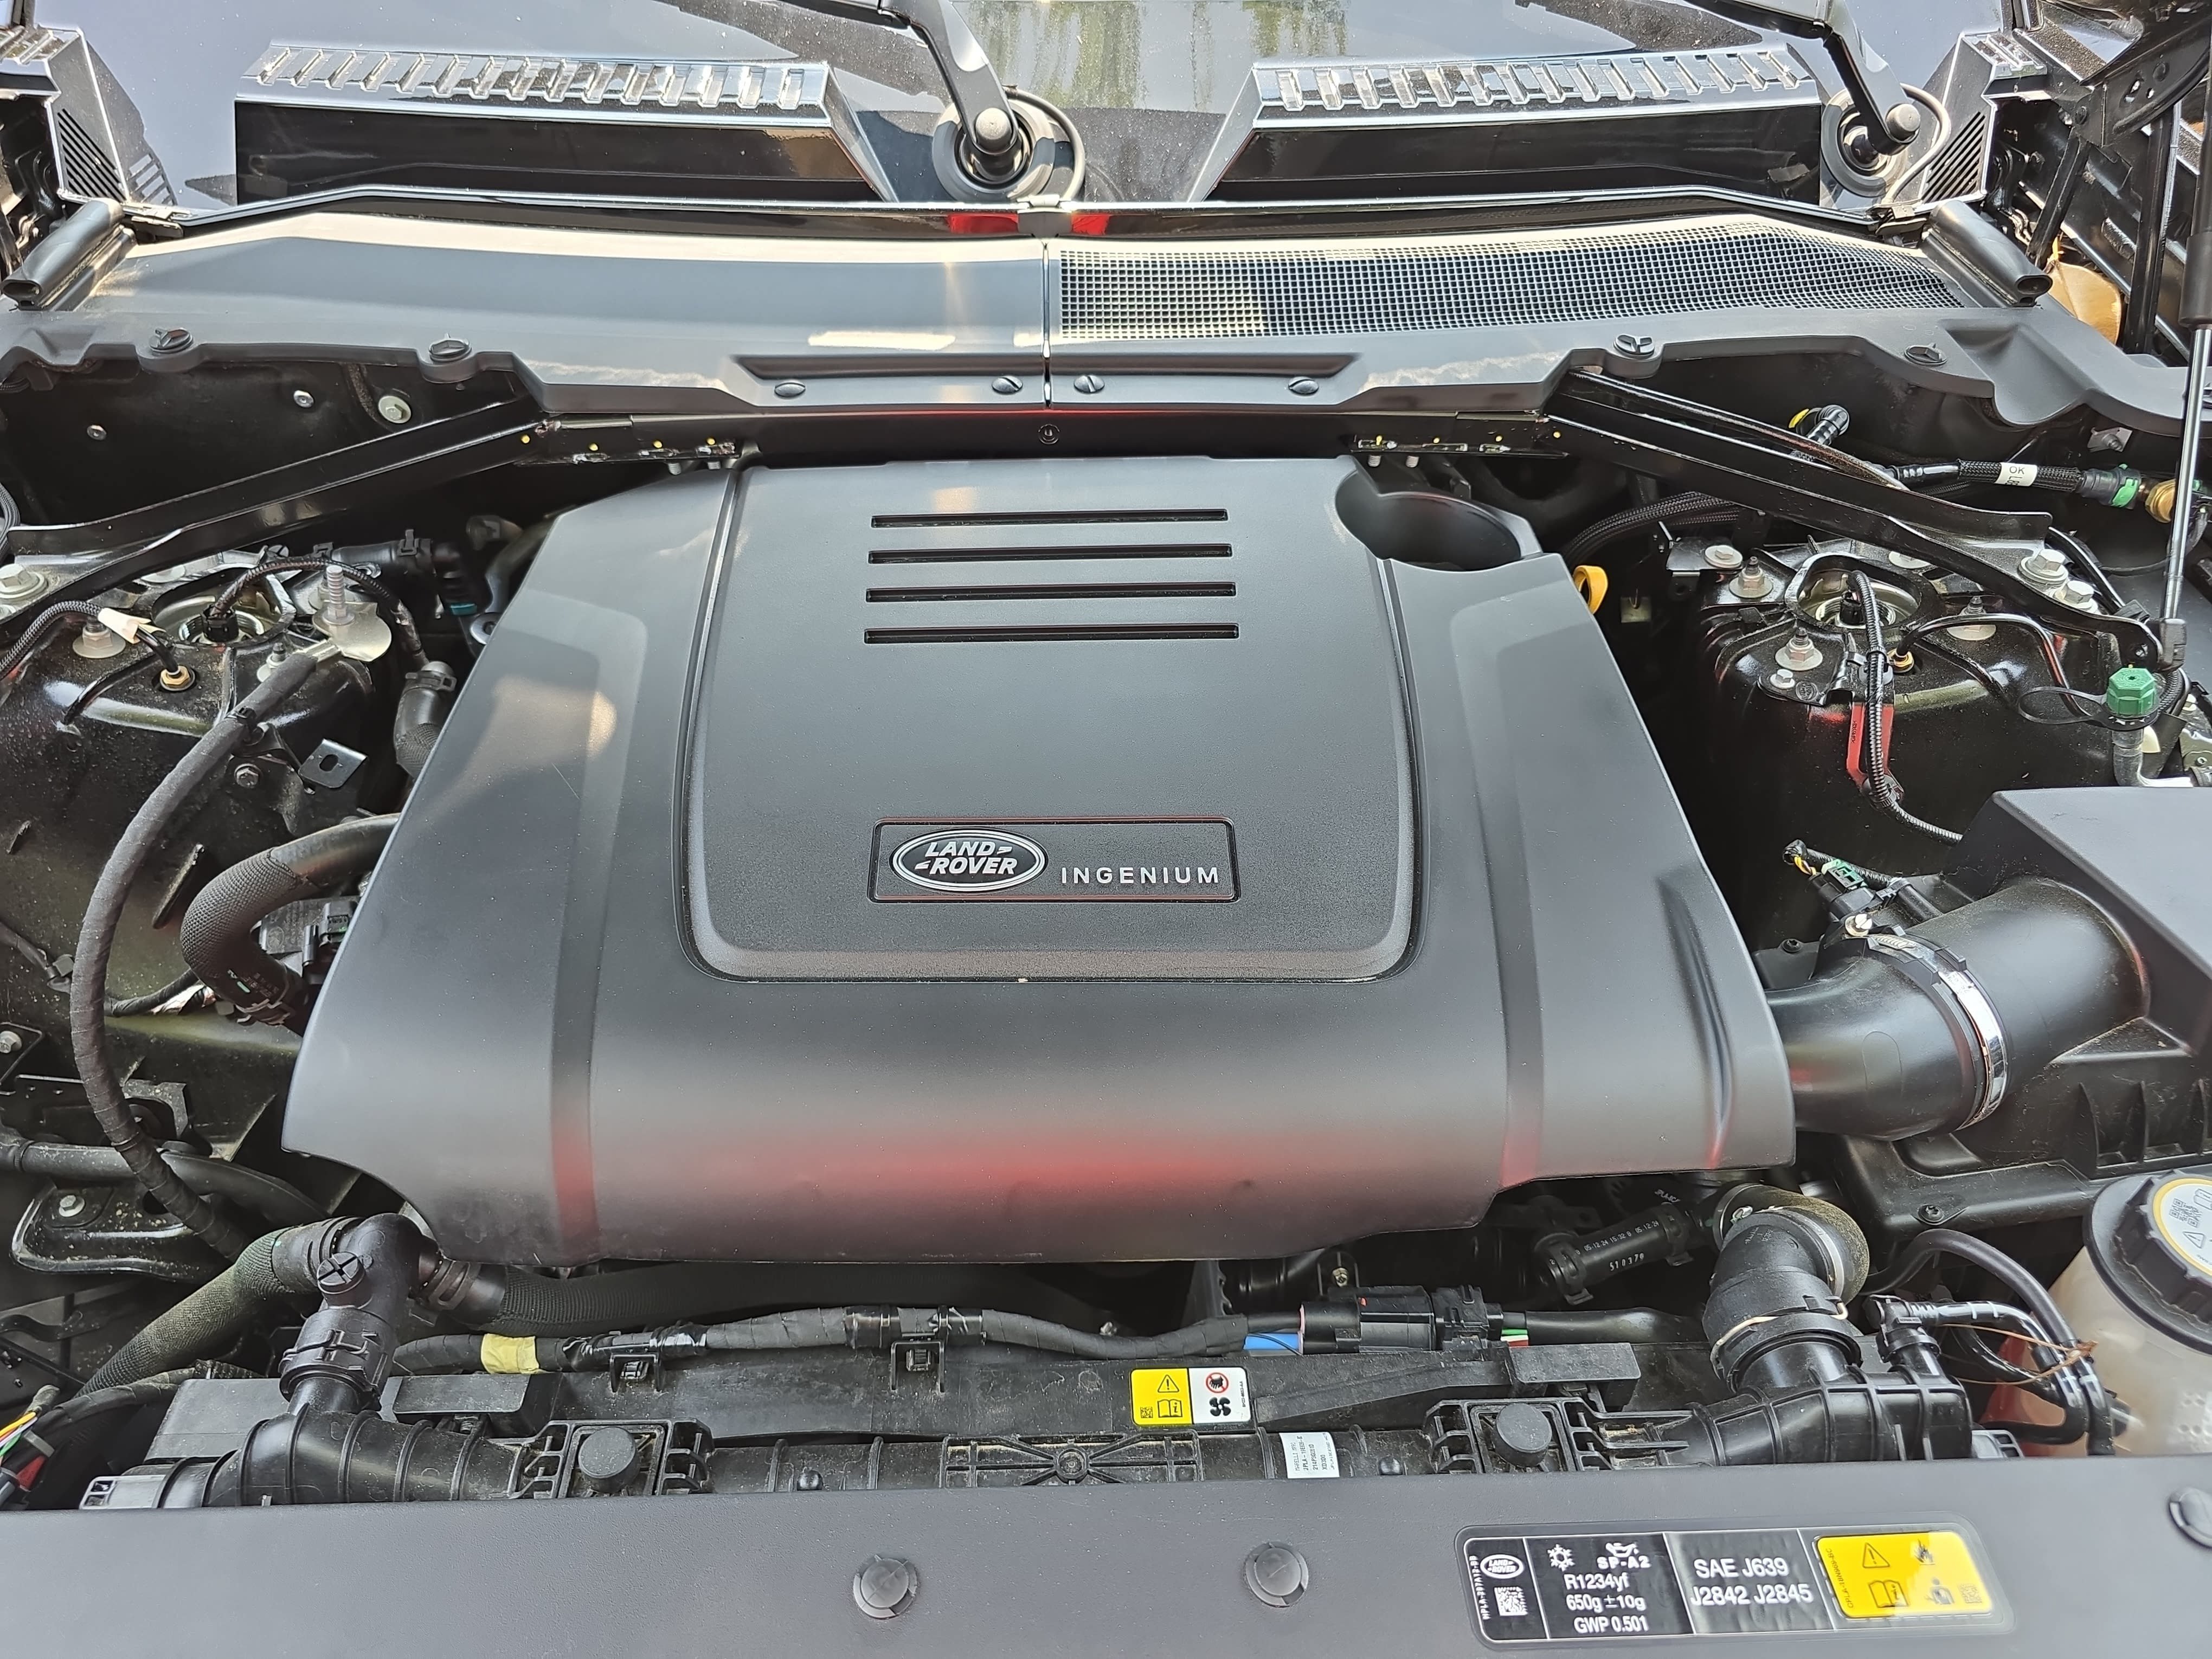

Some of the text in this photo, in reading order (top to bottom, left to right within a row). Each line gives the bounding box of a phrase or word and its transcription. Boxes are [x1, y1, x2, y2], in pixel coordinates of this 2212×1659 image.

[2009, 466, 2025, 475] OK
[924, 840, 996, 857] LAND
[928, 857, 1018, 875] ROVER
[1062, 866, 1219, 884] INGENIUM
[1597, 1555, 1651, 1570] SP-A2
[1694, 1557, 1790, 1578] SAE J639
[1564, 1572, 1630, 1592] R1234yf
[1566, 1593, 1604, 1613] 650g
[1690, 1583, 1814, 1606] J2842 J2845
[1573, 1615, 1649, 1634] GWP 0.501
